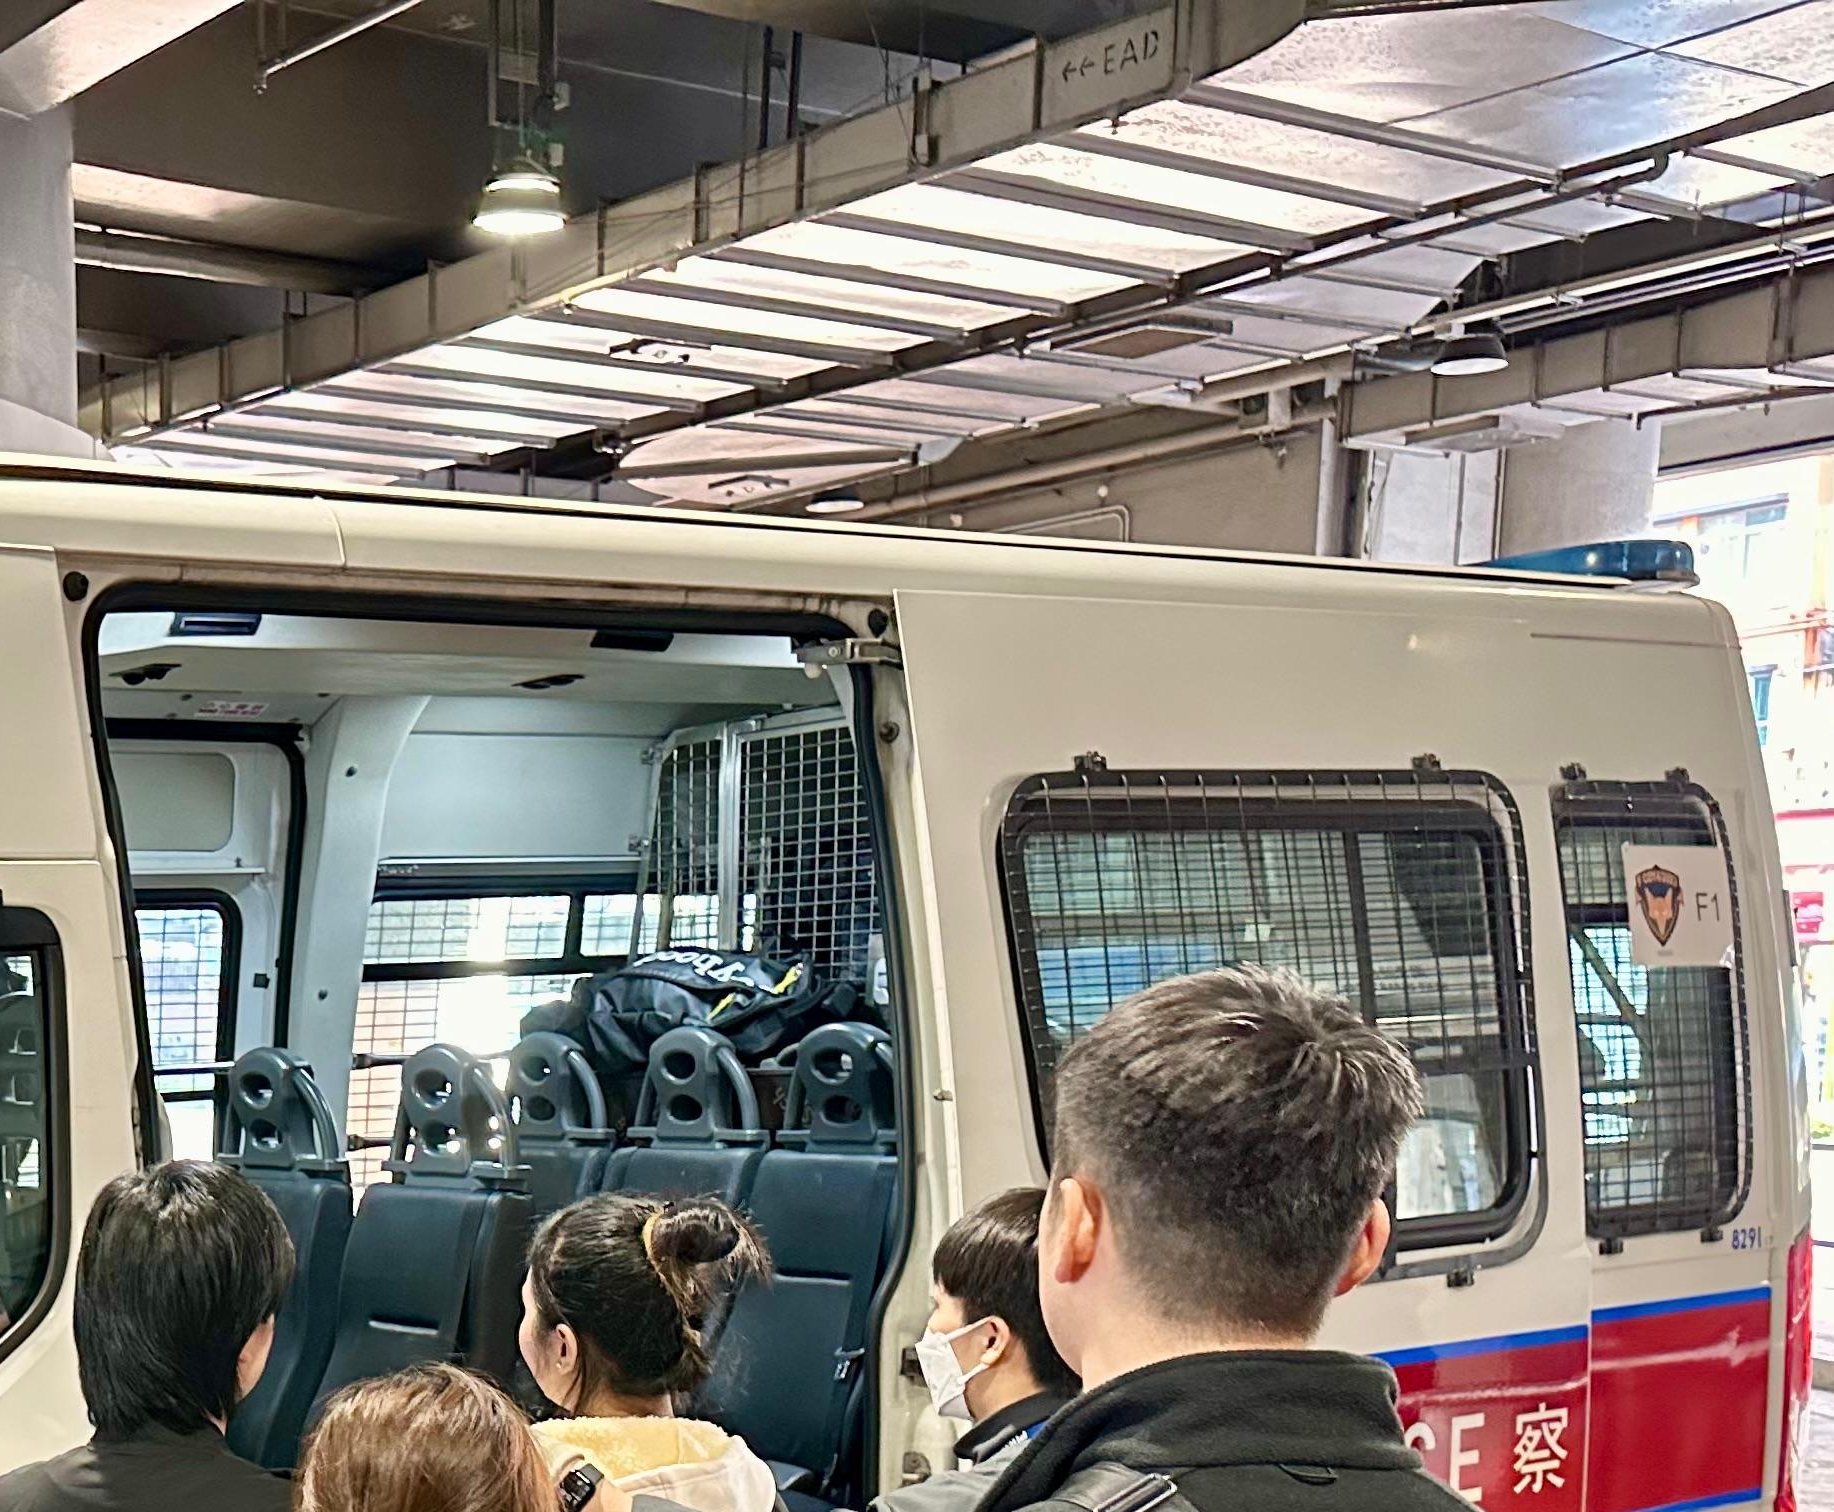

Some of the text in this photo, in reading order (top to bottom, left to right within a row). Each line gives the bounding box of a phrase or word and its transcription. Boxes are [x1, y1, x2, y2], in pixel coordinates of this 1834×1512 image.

[1104, 29, 1159, 75] EAD
[1695, 892, 1720, 922] F1
[1732, 1226, 1762, 1249] 8291
[1513, 1402, 1568, 1494] 察
